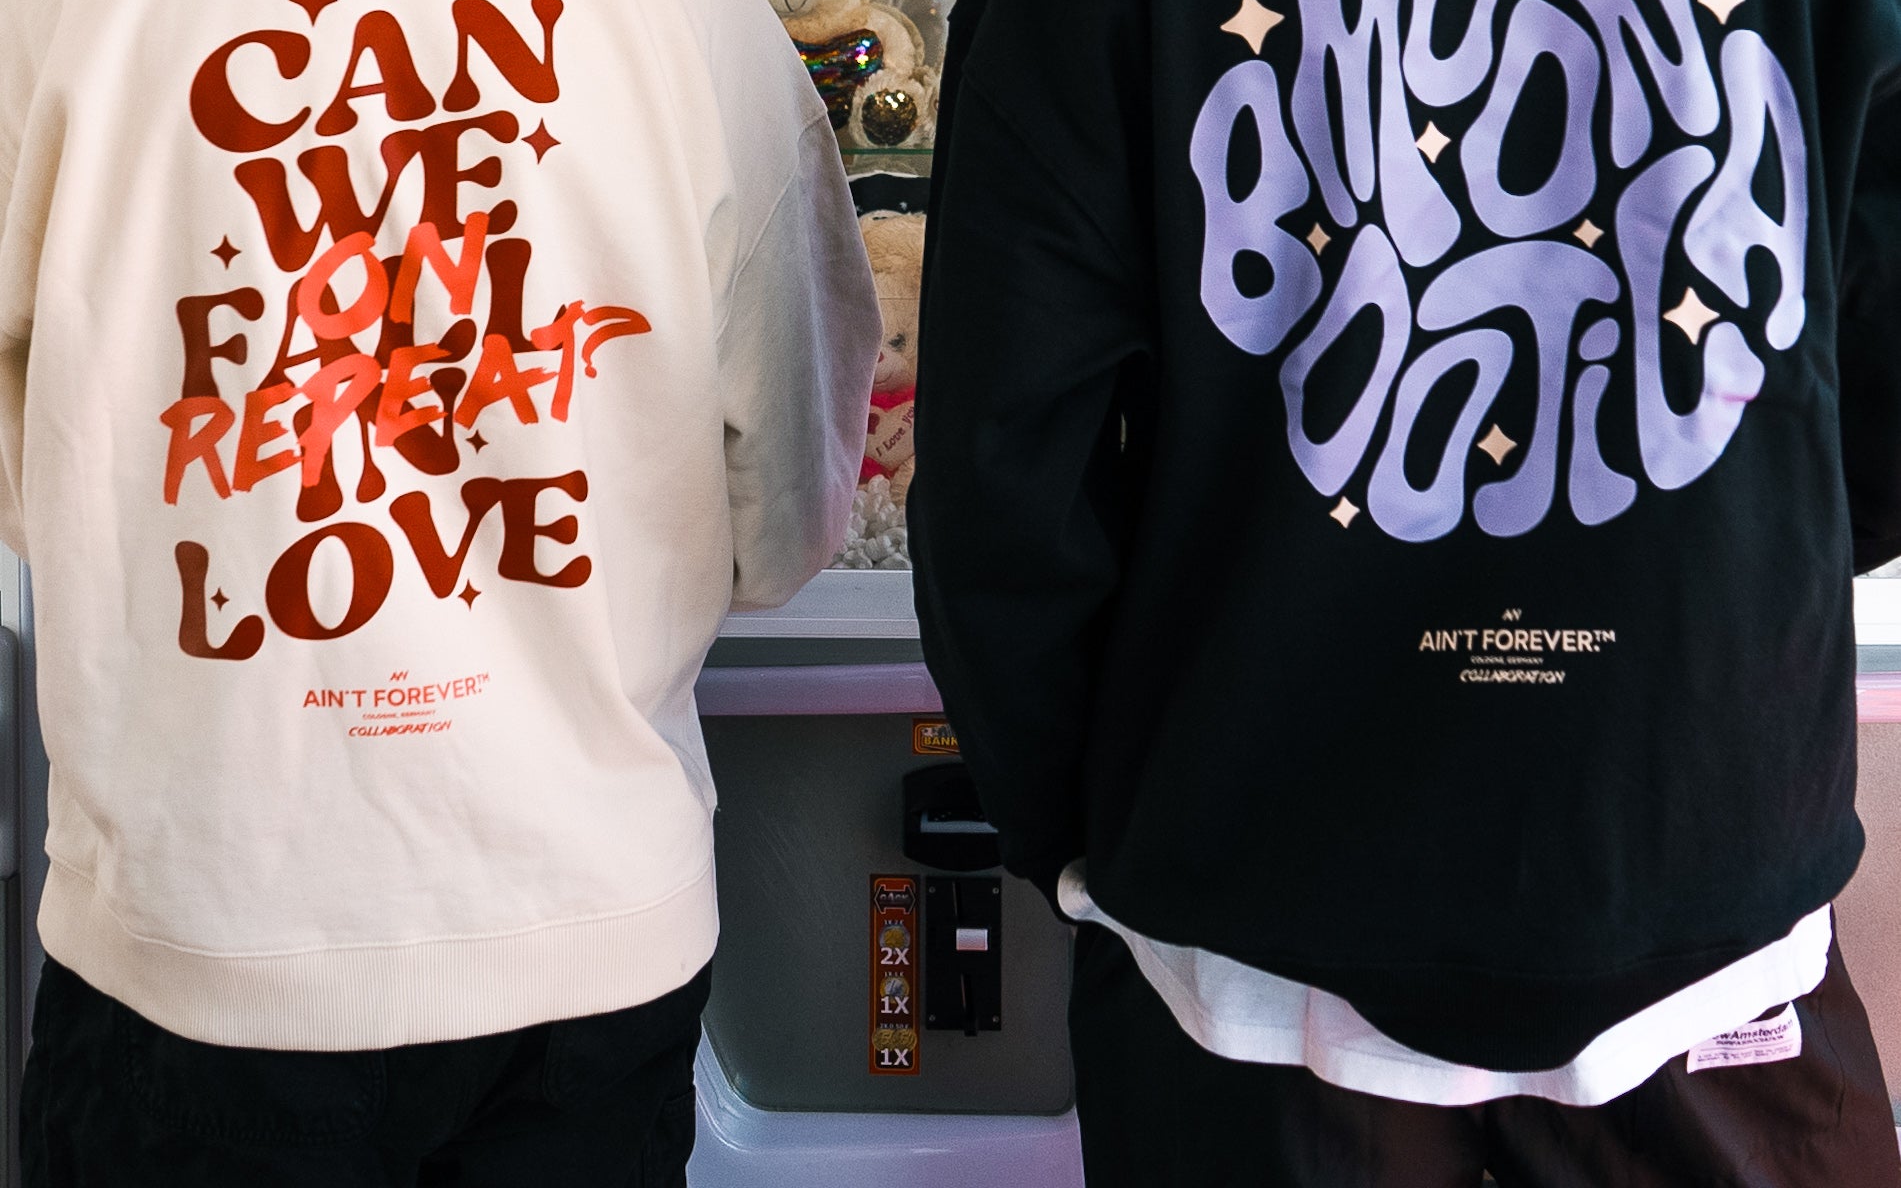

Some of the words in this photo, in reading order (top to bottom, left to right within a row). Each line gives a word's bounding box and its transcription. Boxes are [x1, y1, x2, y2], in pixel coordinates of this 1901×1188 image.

[234, 110, 519, 273] WE
[297, 212, 488, 340] ON
[174, 470, 592, 661] LOVE
[1419, 629, 1478, 652] AIN'T
[303, 689, 367, 708] AIN'T
[880, 947, 910, 965] 2X
[880, 996, 910, 1014] 1X
[880, 1048, 910, 1066] 1X
